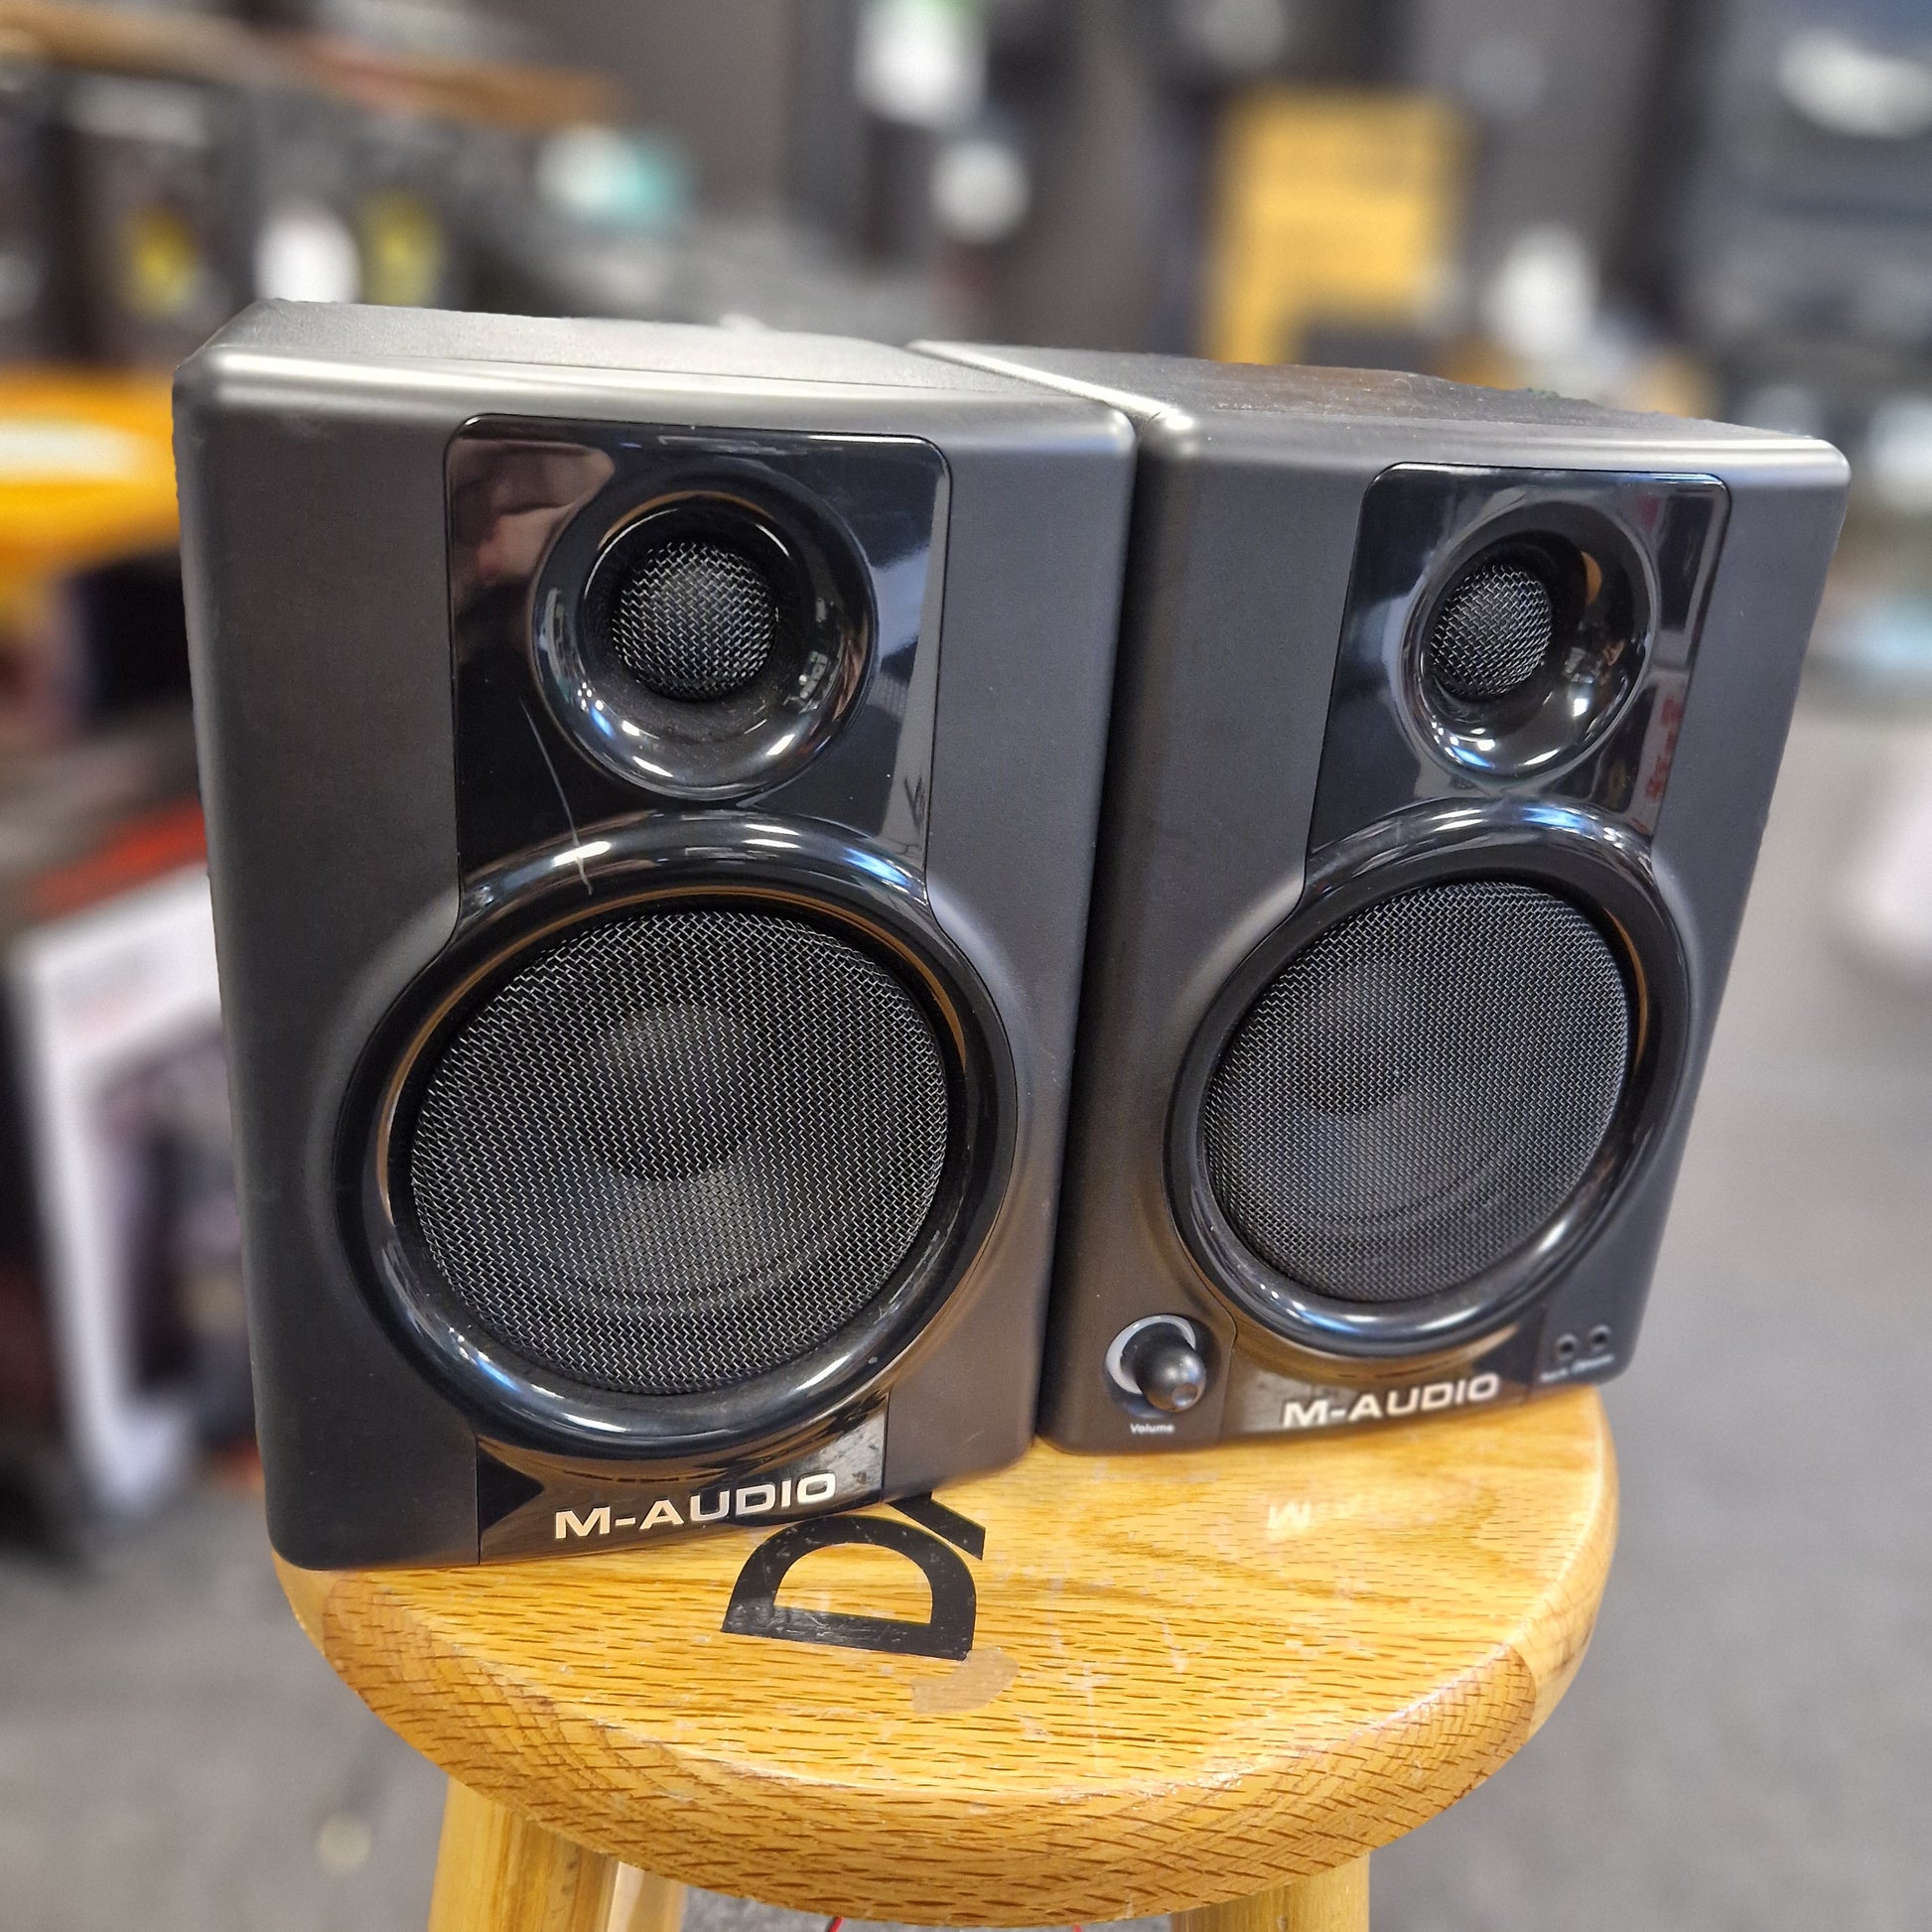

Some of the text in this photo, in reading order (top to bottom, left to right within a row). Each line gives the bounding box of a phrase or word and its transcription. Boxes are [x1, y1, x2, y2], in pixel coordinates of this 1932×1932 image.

[1283, 1373, 1498, 1428] M-AUDIO
[1130, 1423, 1175, 1435] Volume
[556, 1472, 836, 1539] M-AUDIO
